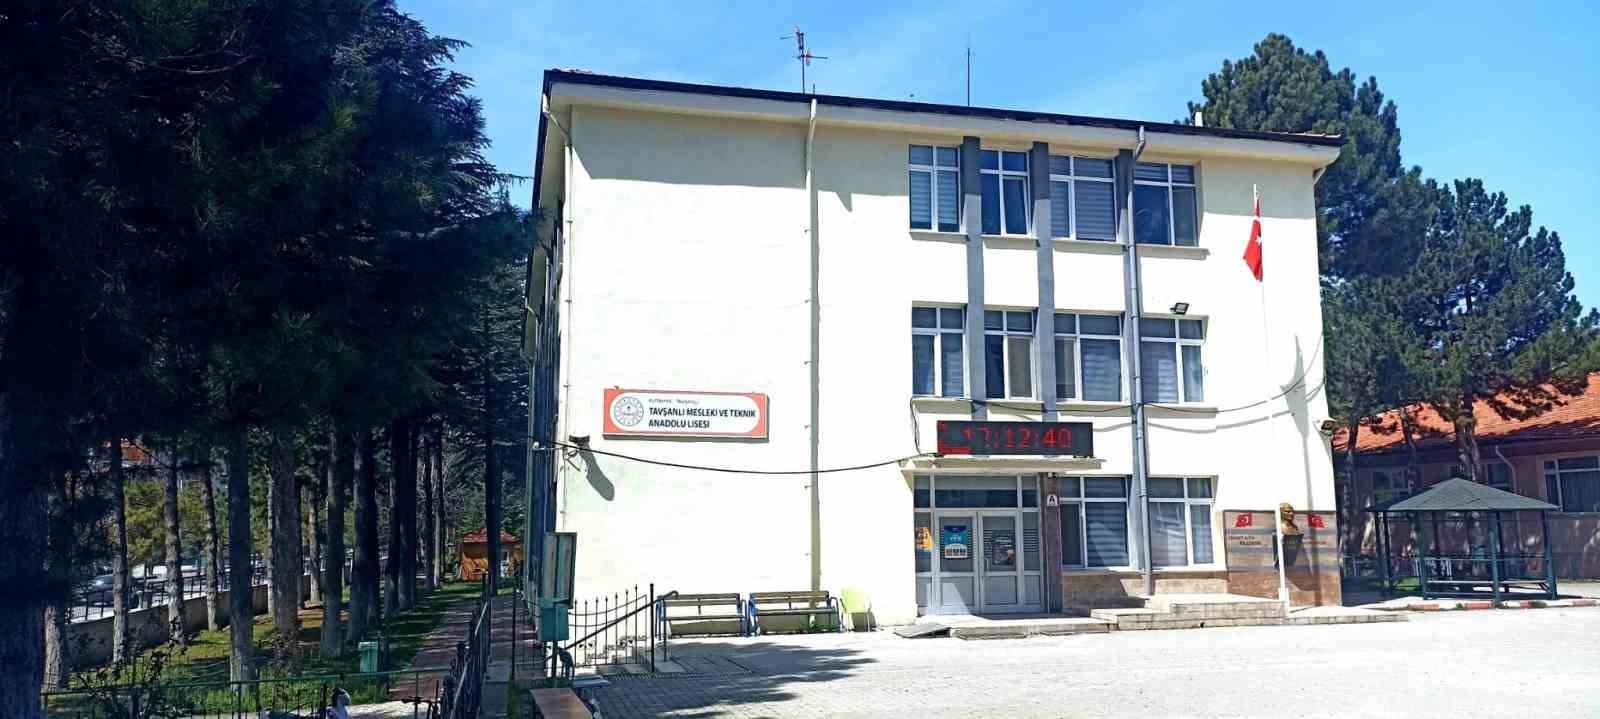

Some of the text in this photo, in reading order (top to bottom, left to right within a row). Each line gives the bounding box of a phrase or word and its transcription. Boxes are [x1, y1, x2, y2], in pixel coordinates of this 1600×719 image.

[649, 407, 685, 417] TAVŞANLI
[719, 409, 729, 417] VE
[648, 419, 686, 428] ANADOLU
